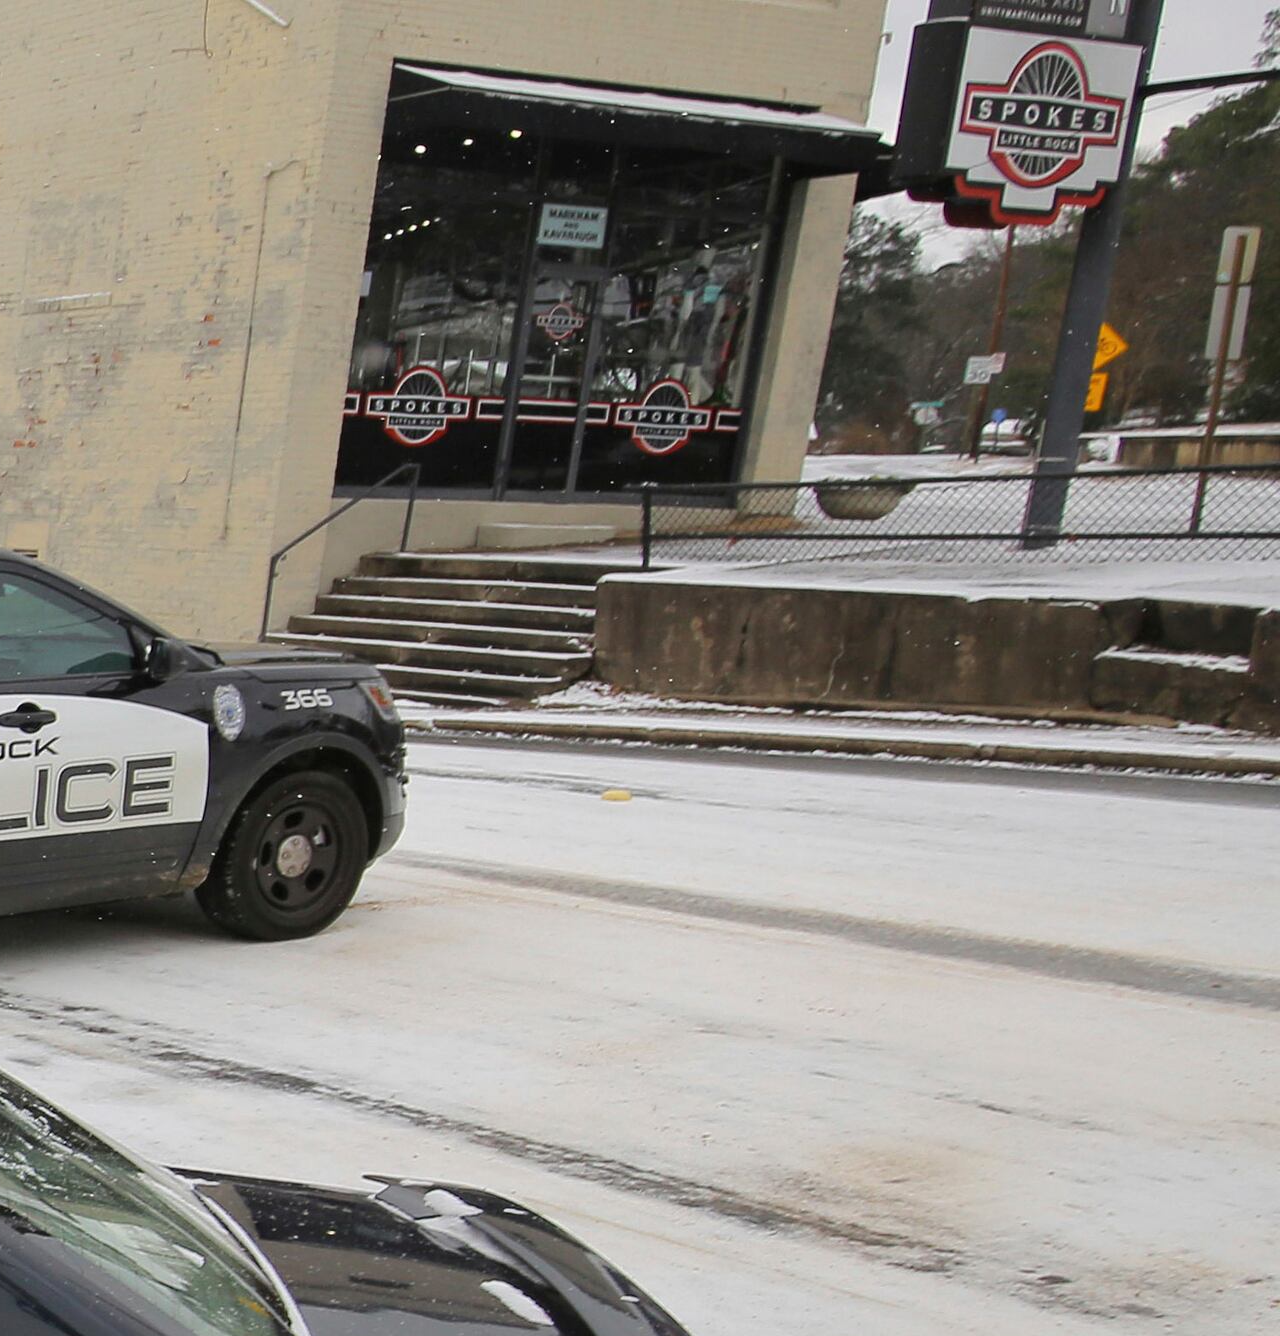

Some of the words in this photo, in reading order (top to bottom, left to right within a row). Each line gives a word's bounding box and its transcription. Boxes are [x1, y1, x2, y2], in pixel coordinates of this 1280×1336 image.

[977, 99, 1109, 132] SPOKES
[999, 132, 1040, 147] LITTLE
[1044, 136, 1077, 151] ROCK
[549, 208, 599, 219] MARKHAM
[374, 400, 462, 414] SPOKES
[623, 409, 703, 425] SPOKES
[280, 688, 333, 710] 366
